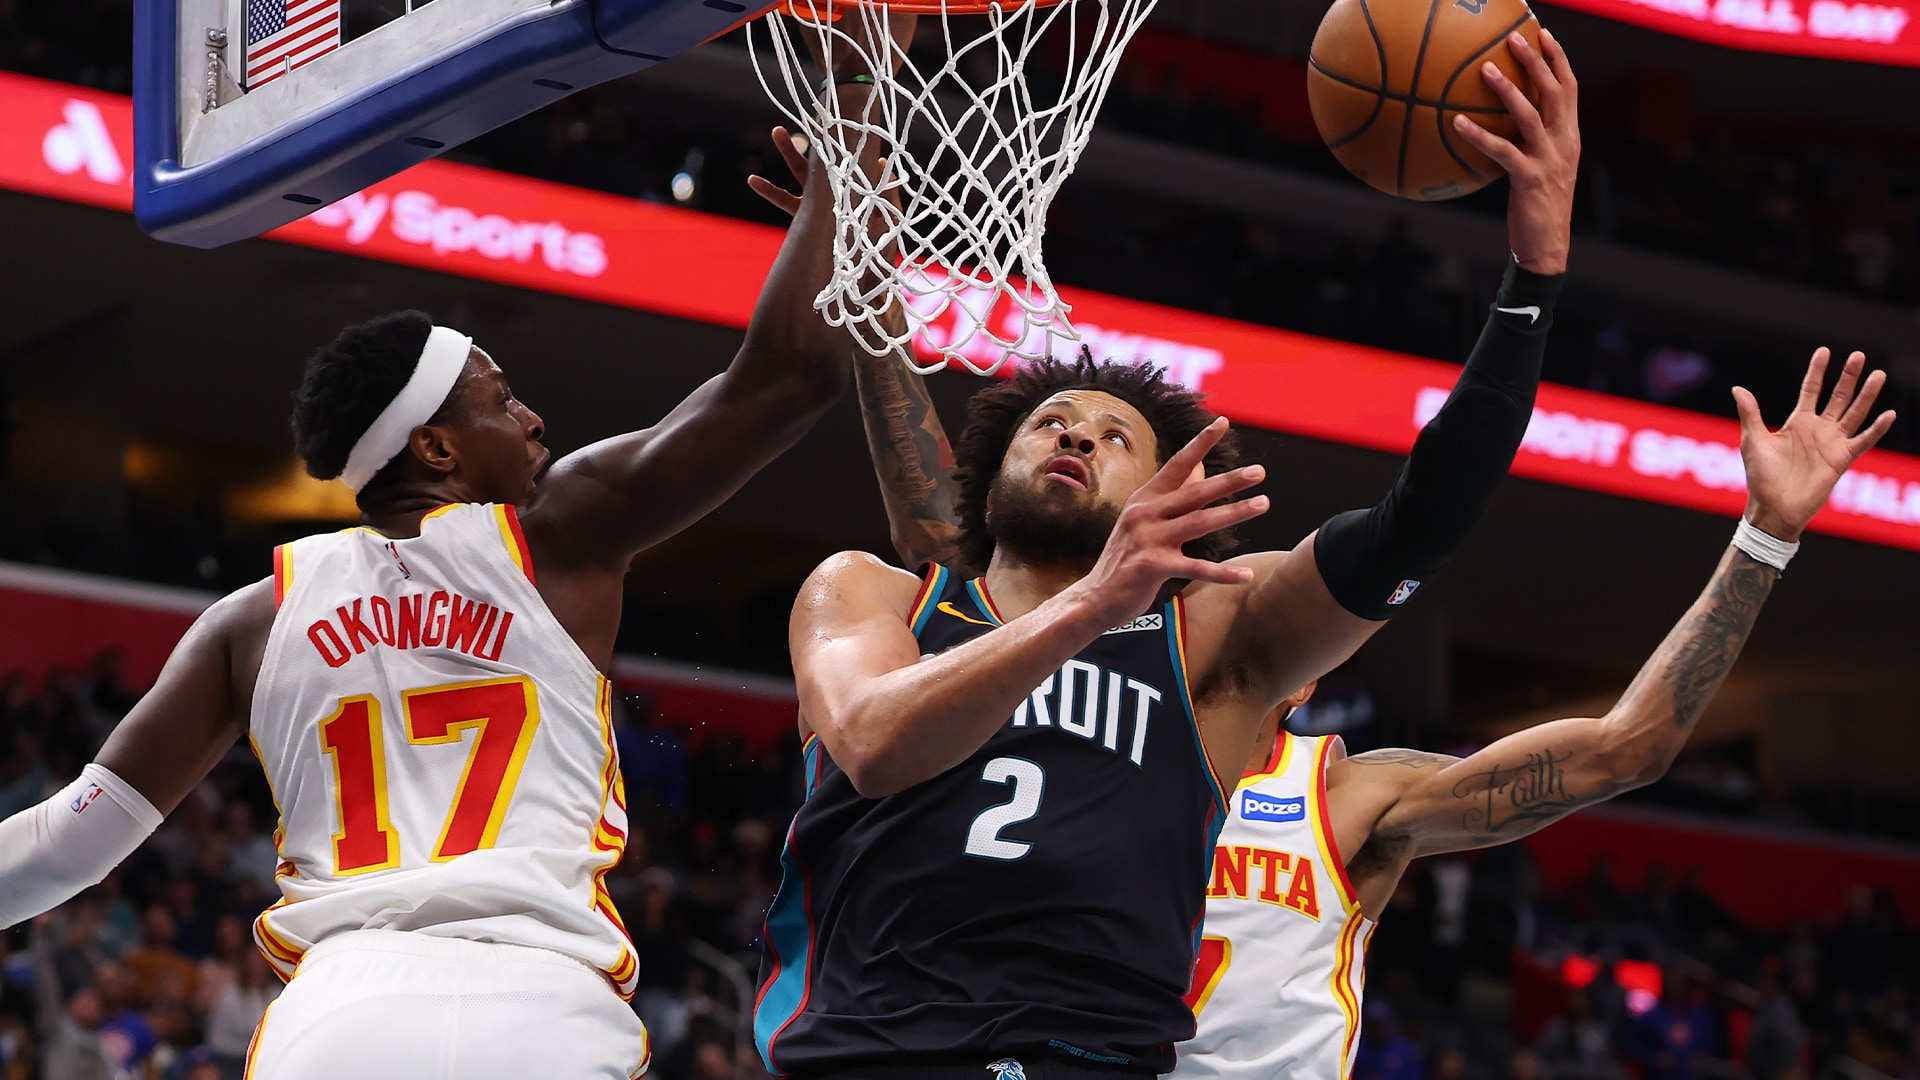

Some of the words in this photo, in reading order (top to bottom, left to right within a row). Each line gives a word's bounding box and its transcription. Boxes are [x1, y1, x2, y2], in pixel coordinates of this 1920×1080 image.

[391, 190, 608, 277] Sports
[1413, 386, 1628, 468] DROIT
[307, 590, 514, 668] OKONGWU
[1011, 656, 1164, 770] ROIT
[318, 675, 541, 876] 17
[962, 755, 1046, 862] 2
[1244, 797, 1302, 815] paze
[1453, 749, 1575, 832] Faith
[1207, 844, 1321, 922] NTA
